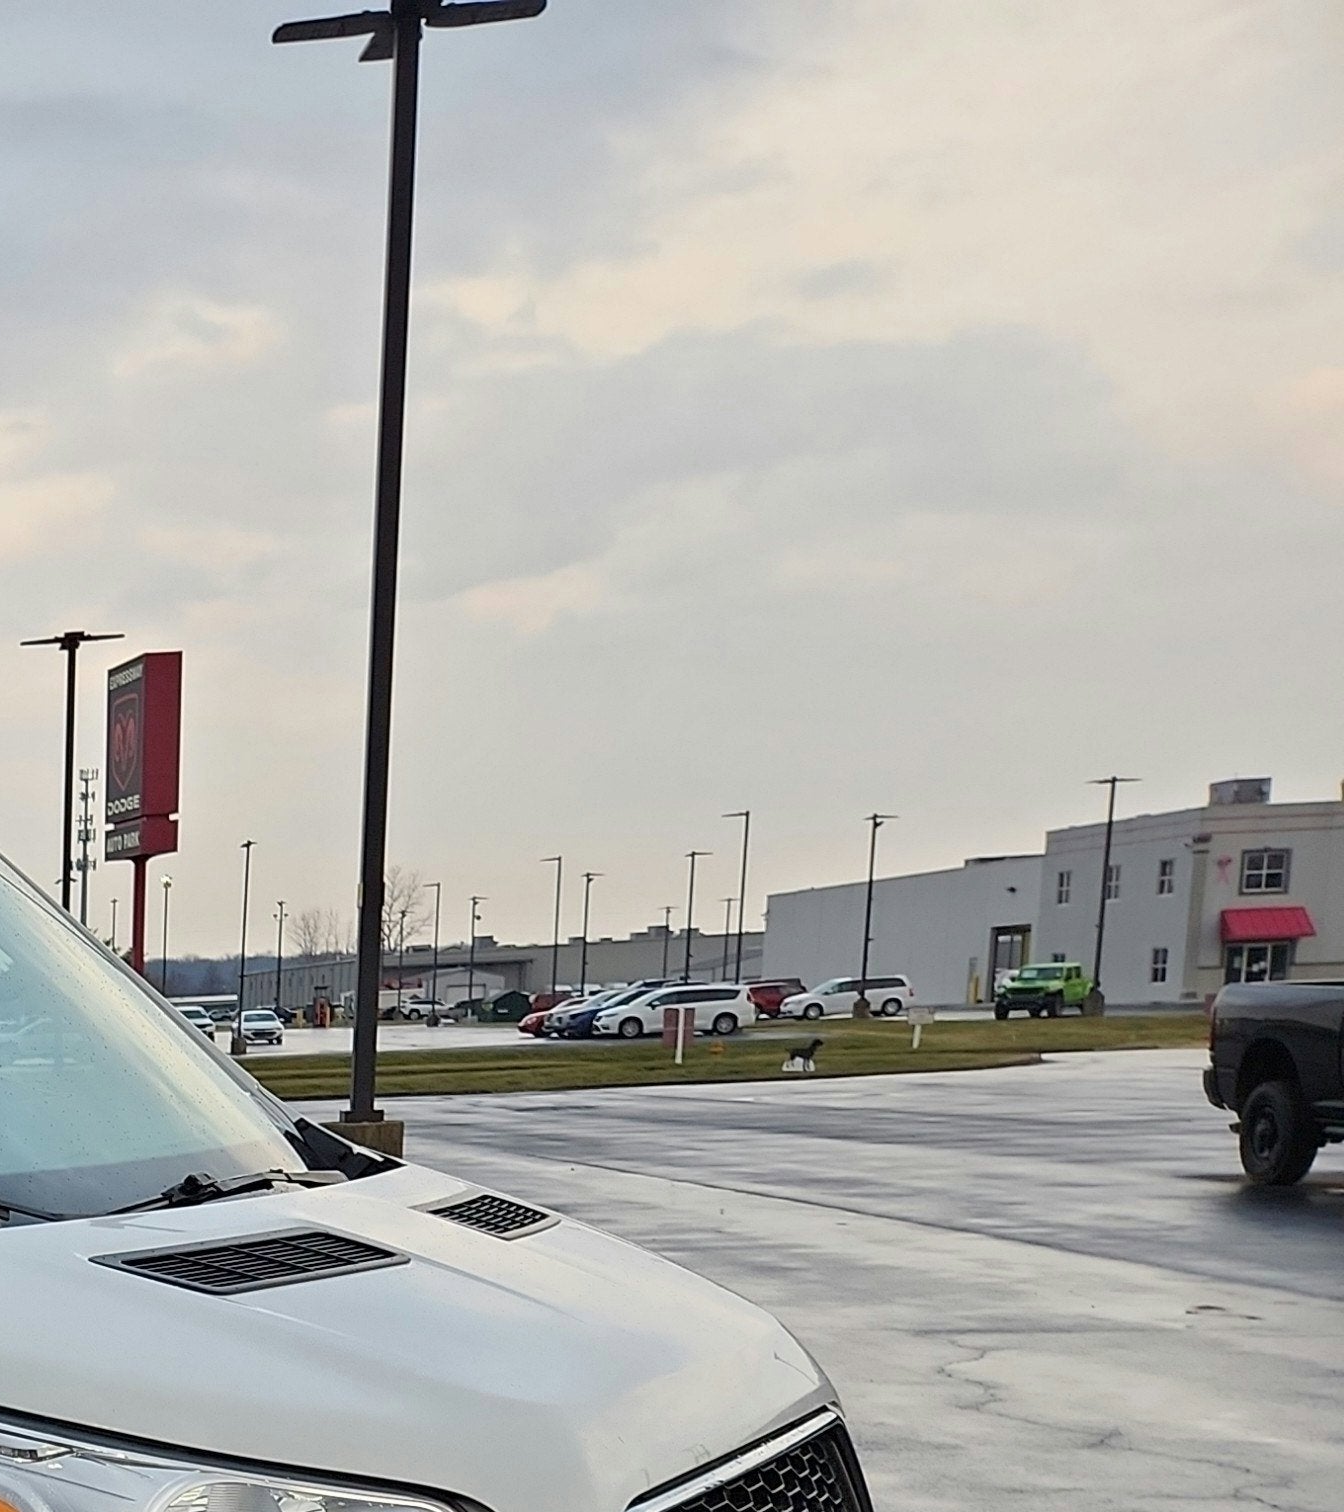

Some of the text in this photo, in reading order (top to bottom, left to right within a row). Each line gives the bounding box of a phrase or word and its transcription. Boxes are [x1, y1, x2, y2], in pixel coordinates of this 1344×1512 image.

[107, 794, 140, 816] DODGE
[107, 831, 140, 853] AUTO PARK
